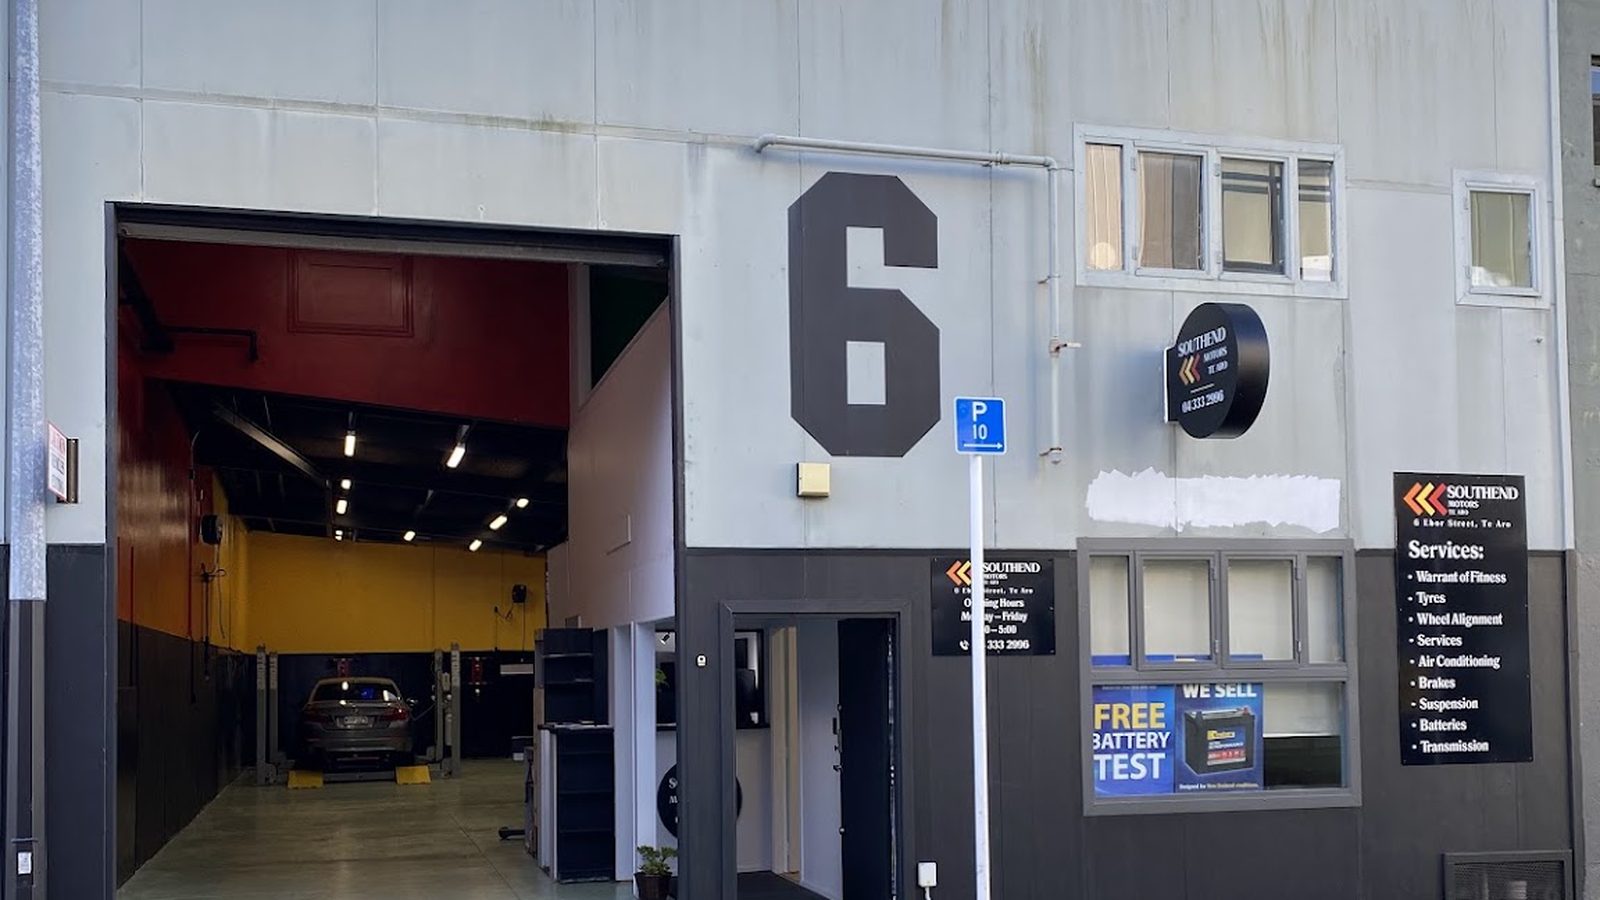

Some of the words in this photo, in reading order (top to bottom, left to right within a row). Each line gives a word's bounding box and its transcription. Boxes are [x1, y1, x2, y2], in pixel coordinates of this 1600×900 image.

[788, 171, 941, 458] 6
[1178, 326, 1226, 357] SOUTHEND
[1204, 347, 1228, 361] MOTORS
[1191, 396, 1205, 411] 333
[973, 401, 987, 421] P
[973, 424, 987, 440] 10
[1447, 485, 1519, 499] SOUTHEND
[1413, 518, 1419, 527] 6
[1423, 518, 1444, 527] Ebor
[1481, 519, 1492, 527] Te
[1496, 519, 1511, 528] Aro
[1408, 540, 1484, 559] Services:
[983, 562, 1040, 573] SOUTHEND
[1416, 570, 1458, 583] Warrant
[1459, 571, 1470, 583] of
[1470, 570, 1507, 583] Fitness
[1000, 598, 1025, 607] Hours
[1416, 591, 1446, 606] Tyres
[1002, 611, 1028, 623] Friday
[1417, 613, 1450, 625] Wheel
[1451, 613, 1503, 628] Alignment
[998, 625, 1017, 634] 5:00
[987, 640, 1004, 649] 333
[1006, 640, 1030, 650] 2996
[1417, 634, 1462, 646] Services
[1418, 655, 1435, 667] Air
[1436, 655, 1500, 670] Conditioning
[1418, 676, 1456, 689] Brakes
[1182, 683, 1210, 699] WE
[1215, 683, 1257, 698] SELL
[1420, 697, 1479, 713] Suspension
[1094, 703, 1166, 730] FREE
[1420, 718, 1467, 732] Batteries
[1420, 740, 1489, 753] Transmission
[1093, 753, 1166, 781] TEST
